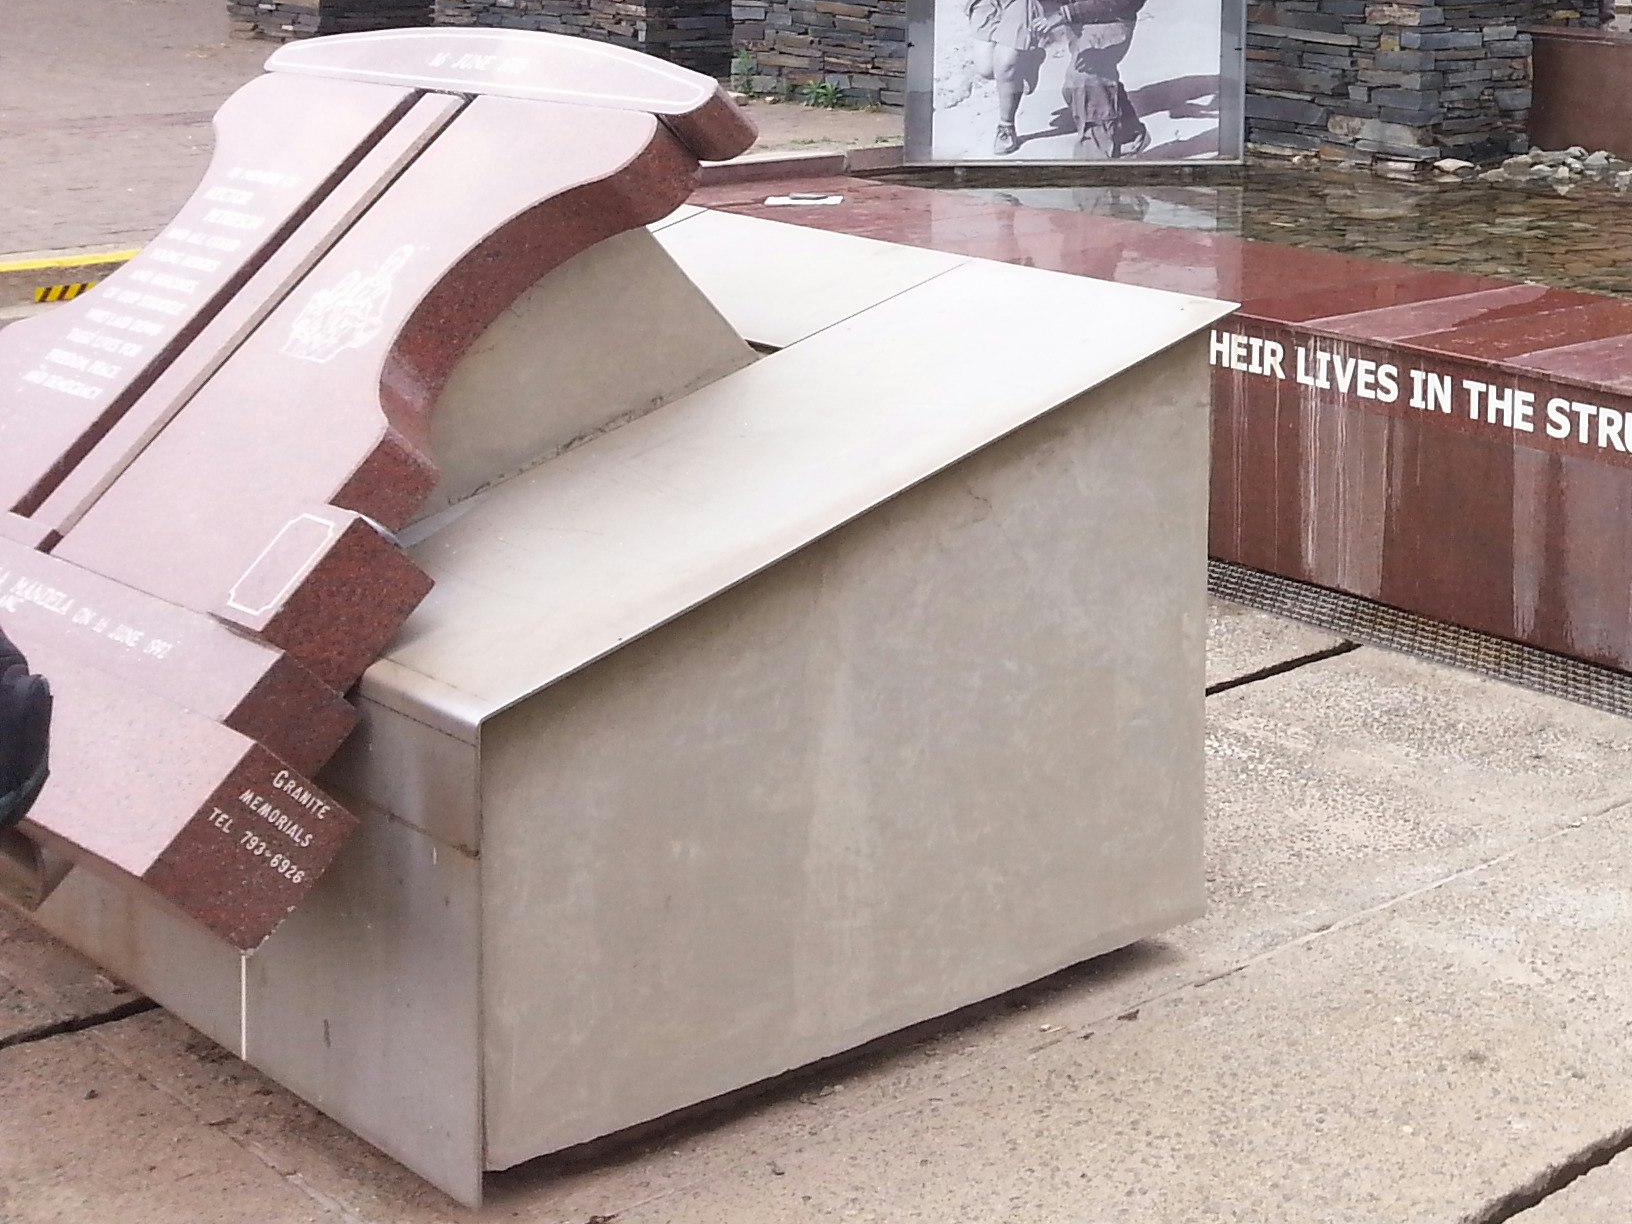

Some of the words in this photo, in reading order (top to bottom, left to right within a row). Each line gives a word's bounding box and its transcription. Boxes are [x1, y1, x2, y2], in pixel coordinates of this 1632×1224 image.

[451, 53, 497, 70] JUNE
[1296, 346, 1399, 403] LIVES
[1410, 369, 1452, 414] IN
[1463, 380, 1534, 432] THE
[10, 576, 75, 615] MANDELA
[108, 624, 144, 646] JUNE
[208, 807, 234, 834] TEL
[239, 789, 313, 848] MEMORIALS
[272, 770, 331, 820] GRANITE
